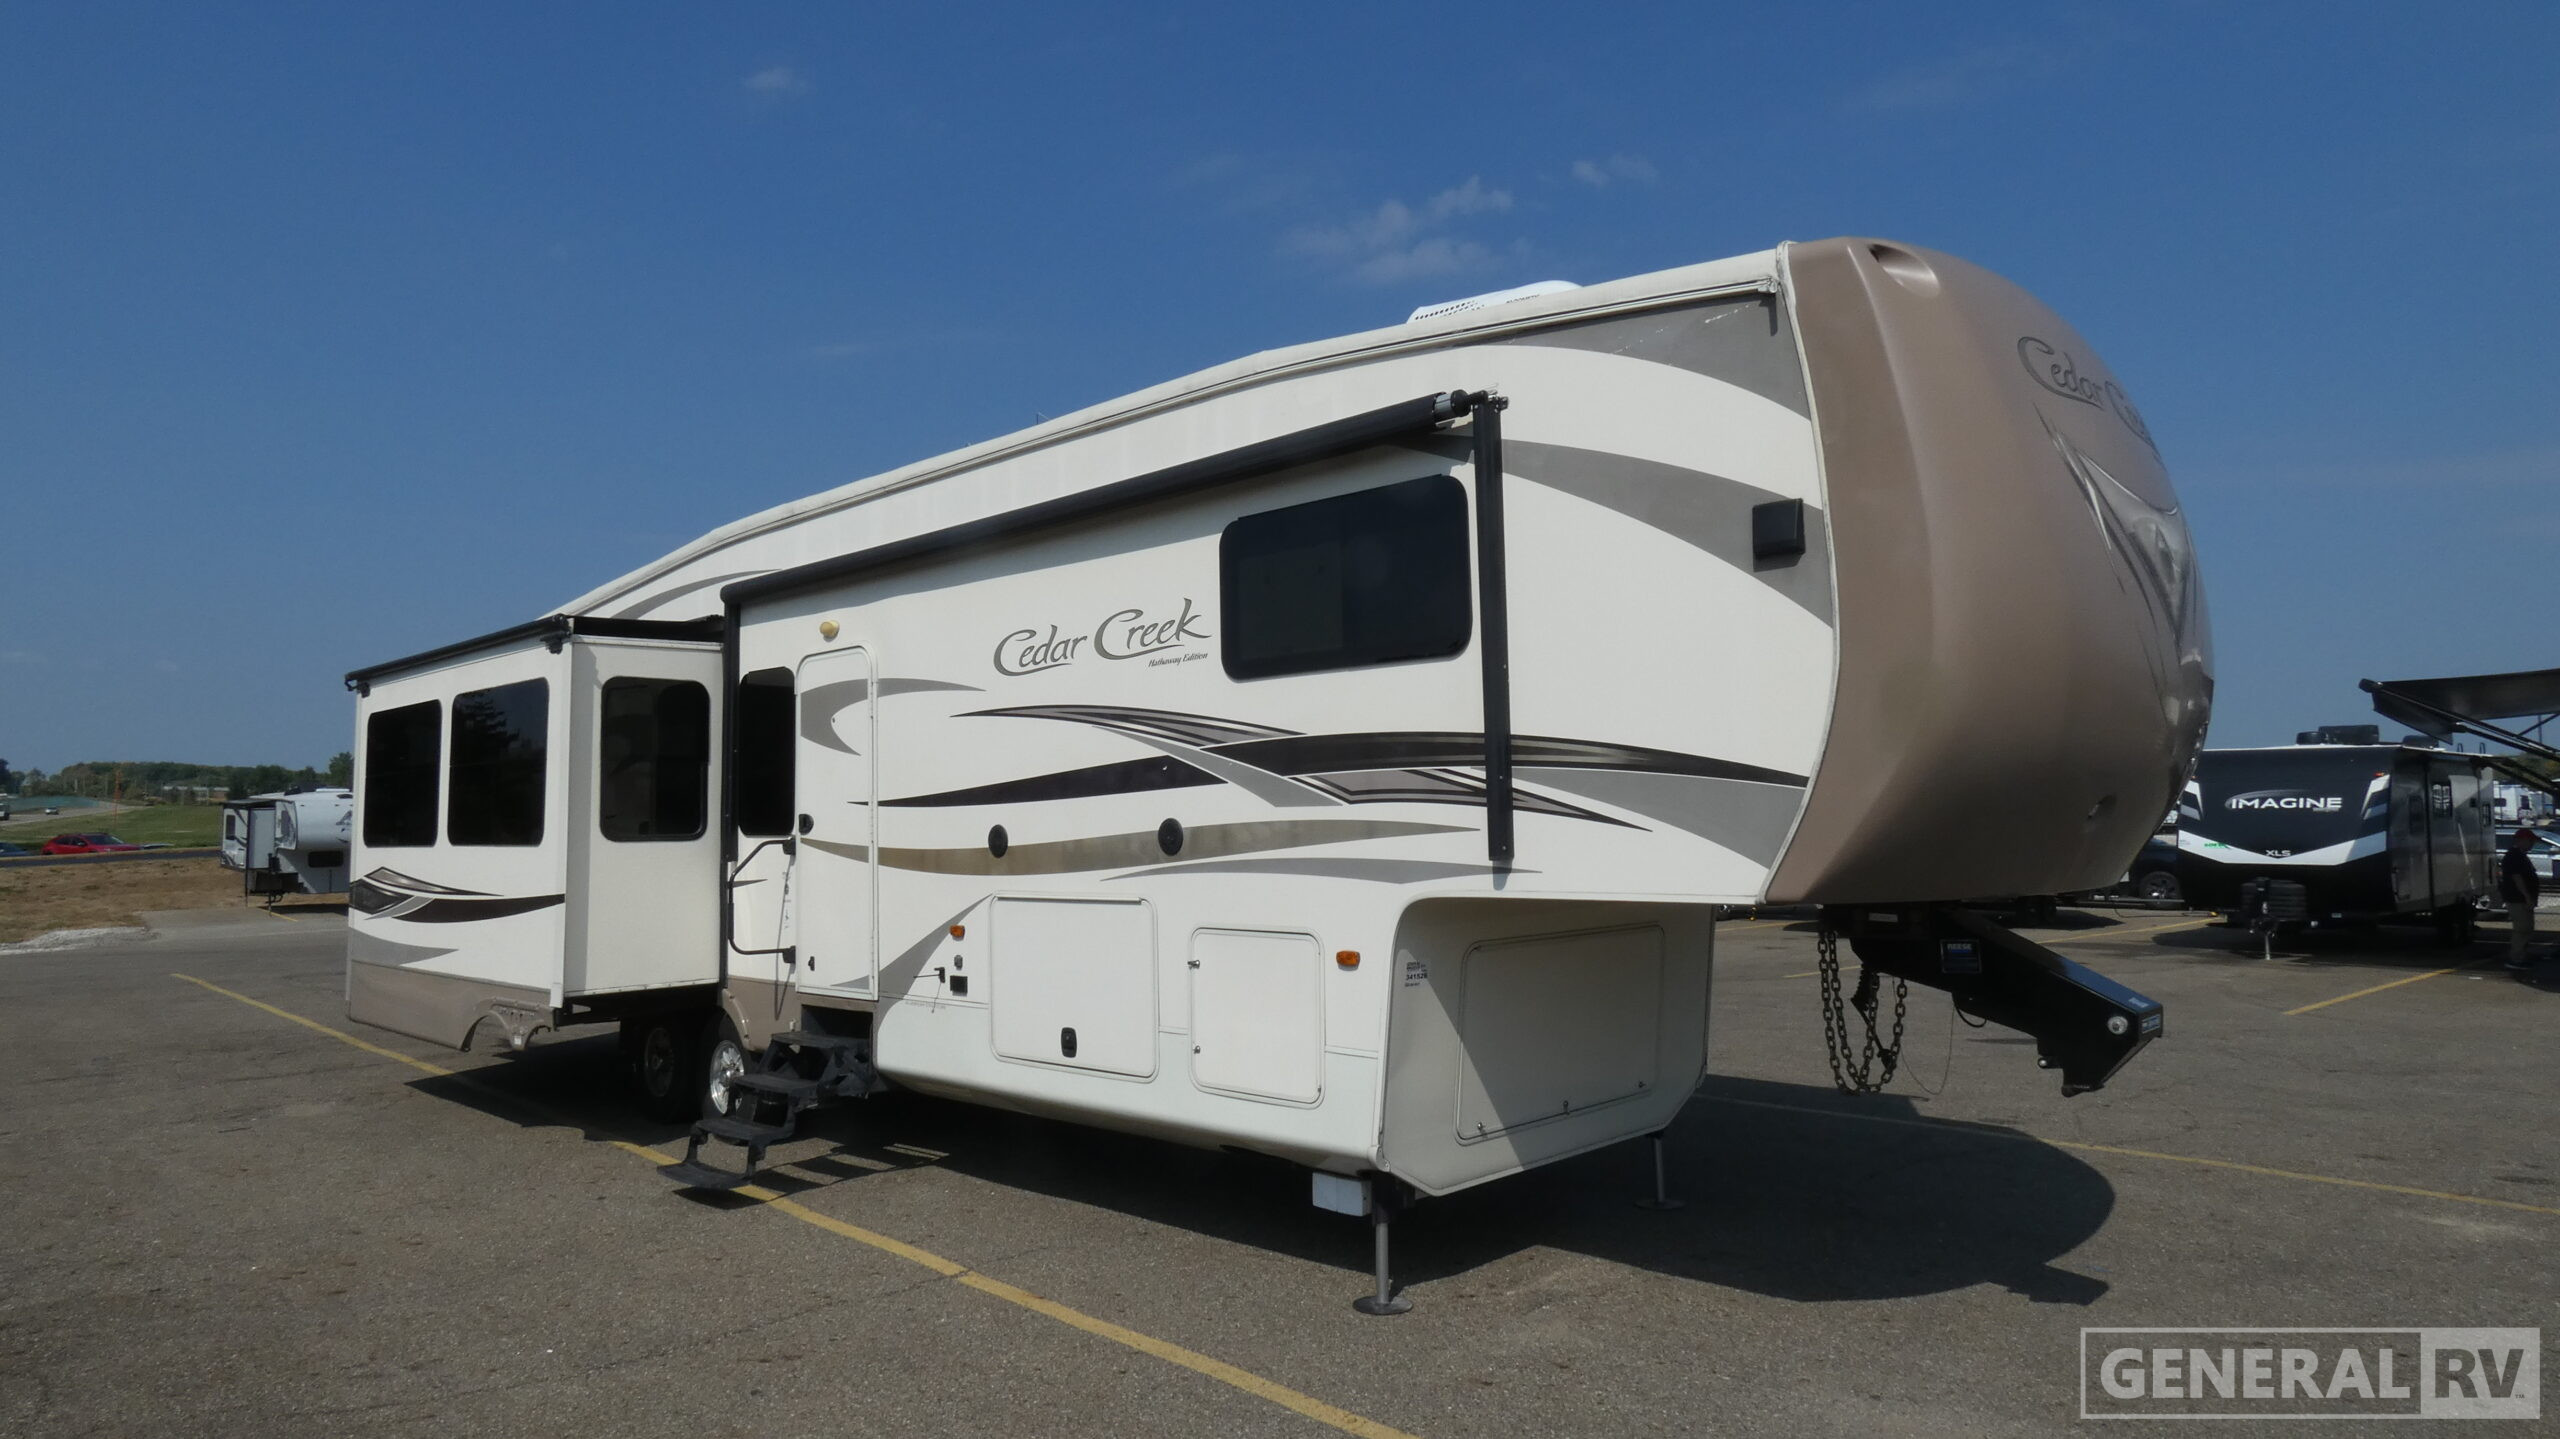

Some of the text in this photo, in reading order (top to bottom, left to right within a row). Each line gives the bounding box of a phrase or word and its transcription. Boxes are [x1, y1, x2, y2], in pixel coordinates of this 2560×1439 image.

[2017, 336, 2105, 412] Cedar
[993, 597, 1212, 677] Cedar Creek
[1182, 652, 1208, 663] Edition
[2231, 797, 2343, 809] IMAGINE
[2265, 849, 2292, 857] XLS
